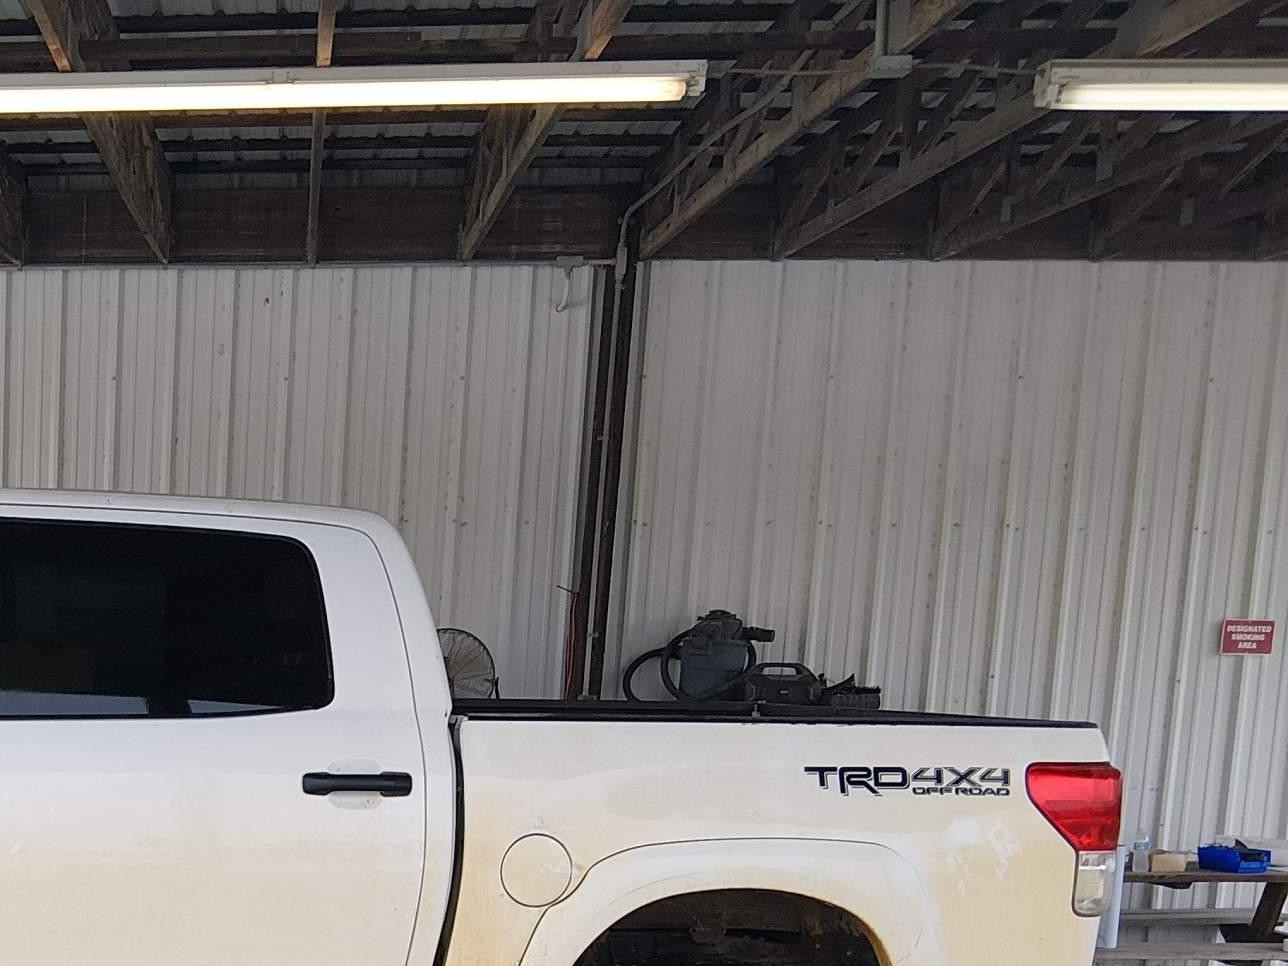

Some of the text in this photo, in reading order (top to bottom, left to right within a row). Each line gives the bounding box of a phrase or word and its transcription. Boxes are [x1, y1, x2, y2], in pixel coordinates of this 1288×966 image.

[804, 766, 911, 796] TRD
[912, 787, 1010, 796] OFF ROAD
